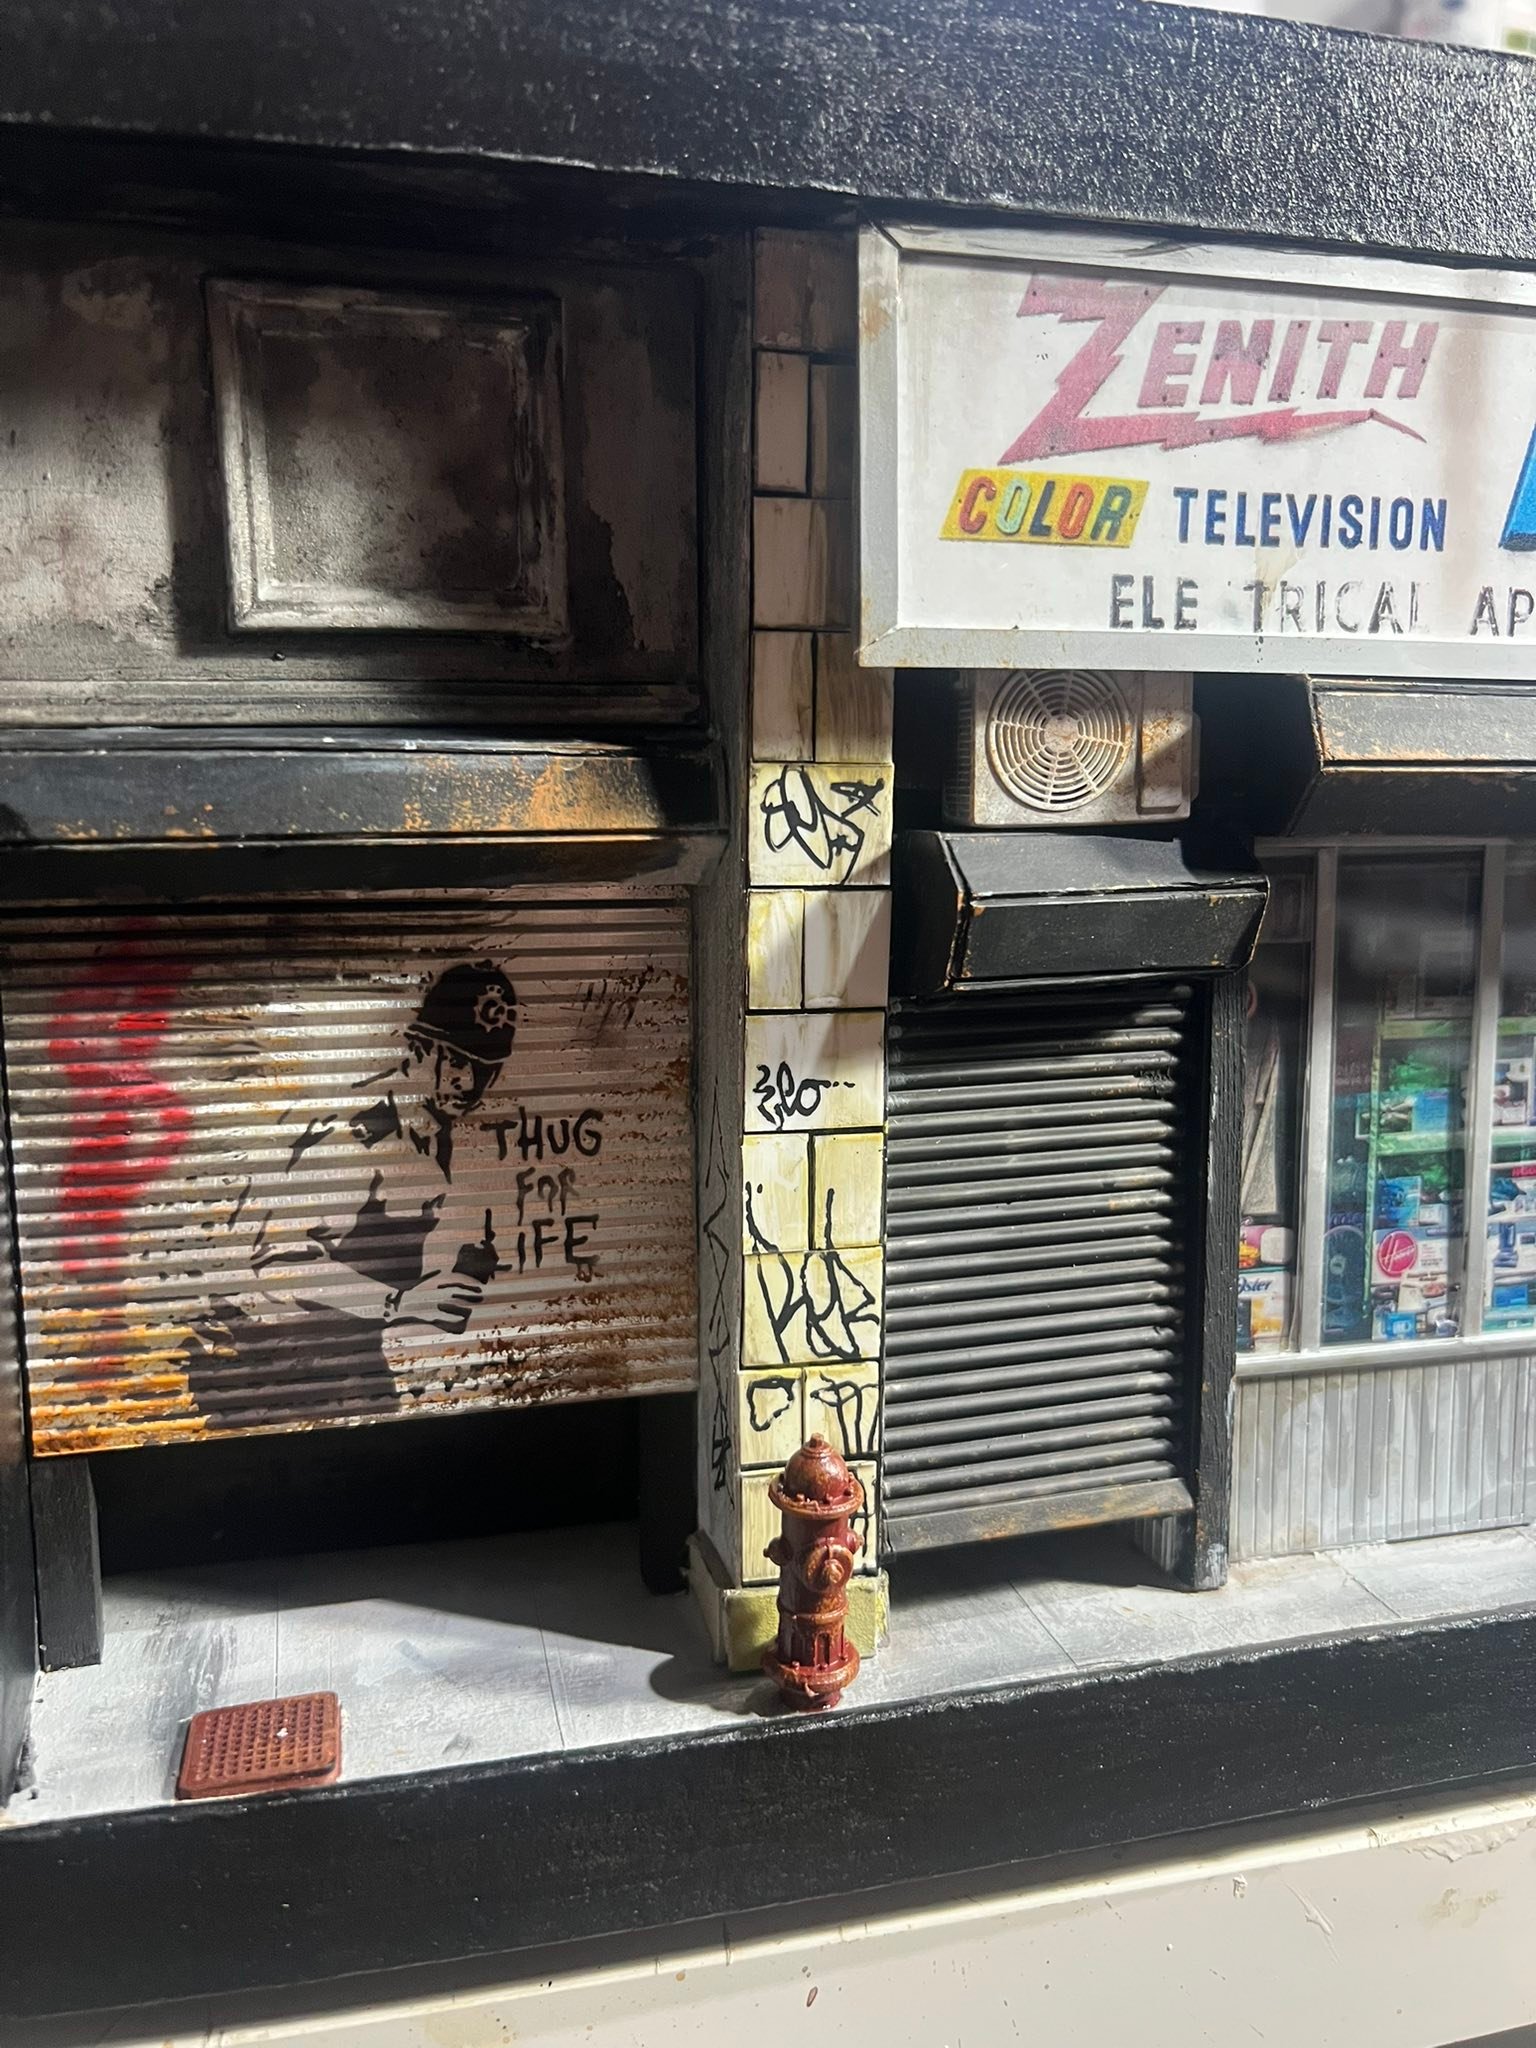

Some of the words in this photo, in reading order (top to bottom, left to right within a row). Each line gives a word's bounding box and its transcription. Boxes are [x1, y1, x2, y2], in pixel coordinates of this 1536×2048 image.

[997, 270, 1440, 466] ZENITH
[959, 475, 1132, 541] COLOR
[1172, 486, 1448, 553] TELEVISION
[479, 1105, 603, 1162] THUG
